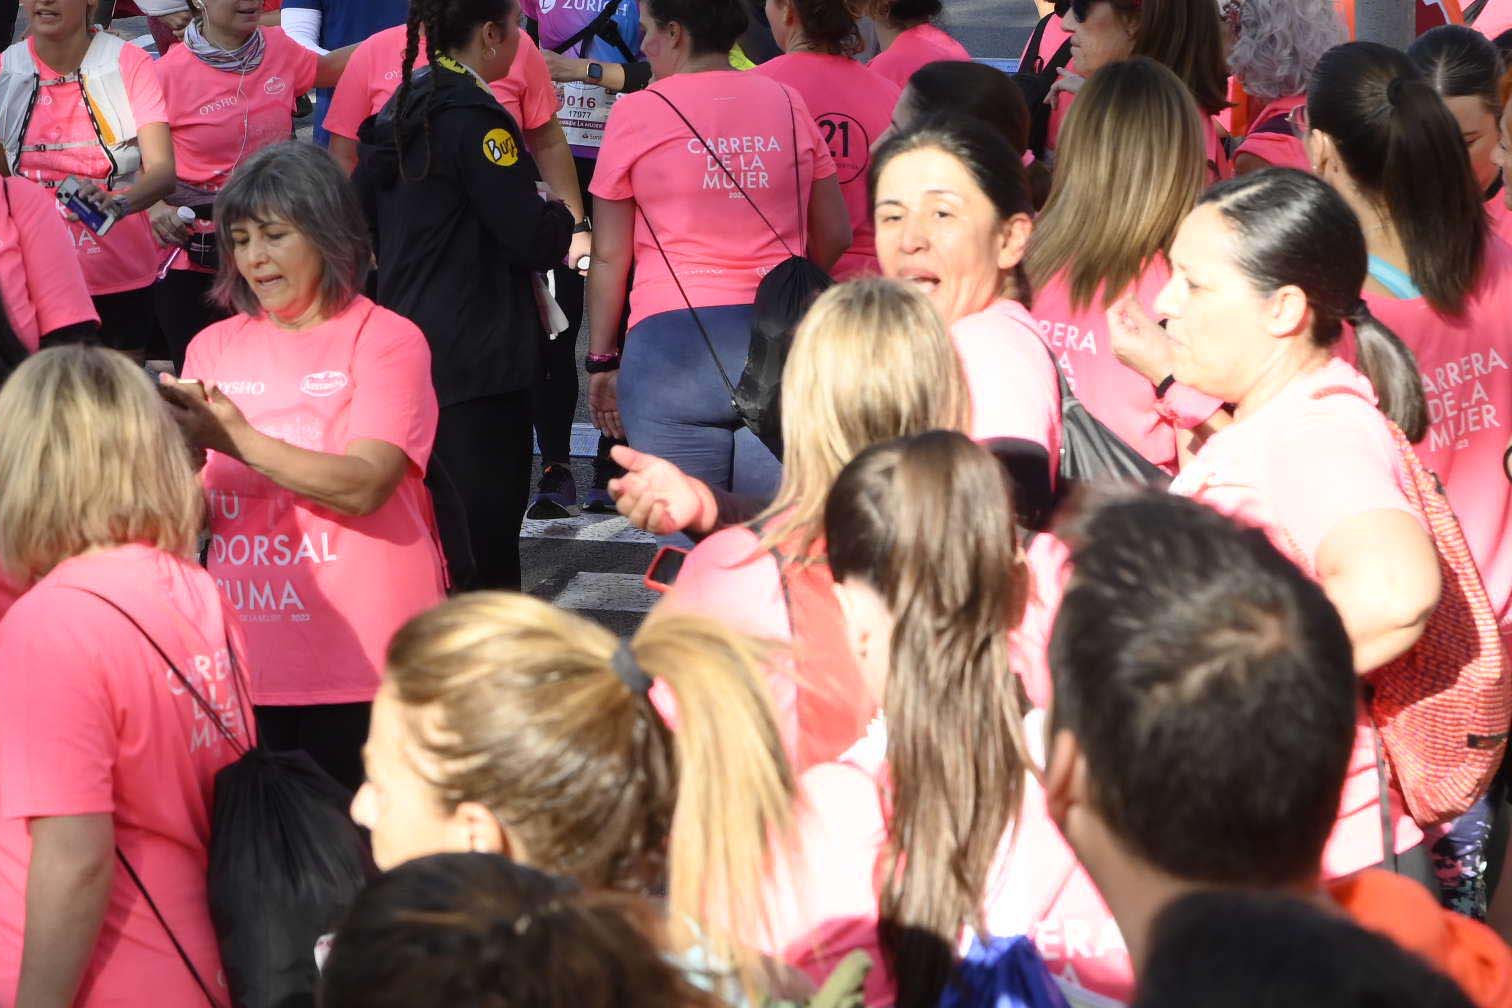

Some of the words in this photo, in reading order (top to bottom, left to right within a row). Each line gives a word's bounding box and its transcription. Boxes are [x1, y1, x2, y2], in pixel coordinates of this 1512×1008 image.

[199, 95, 239, 117] OYSHO
[567, 94, 597, 109] 016
[568, 109, 592, 119] 17977
[688, 135, 782, 155] CARRERA
[818, 118, 849, 159] 21
[707, 154, 732, 172] DE
[740, 155, 765, 171] LA
[702, 172, 770, 191] MUJER
[1429, 393, 1460, 423] DE
[213, 530, 338, 567] DORSAL
